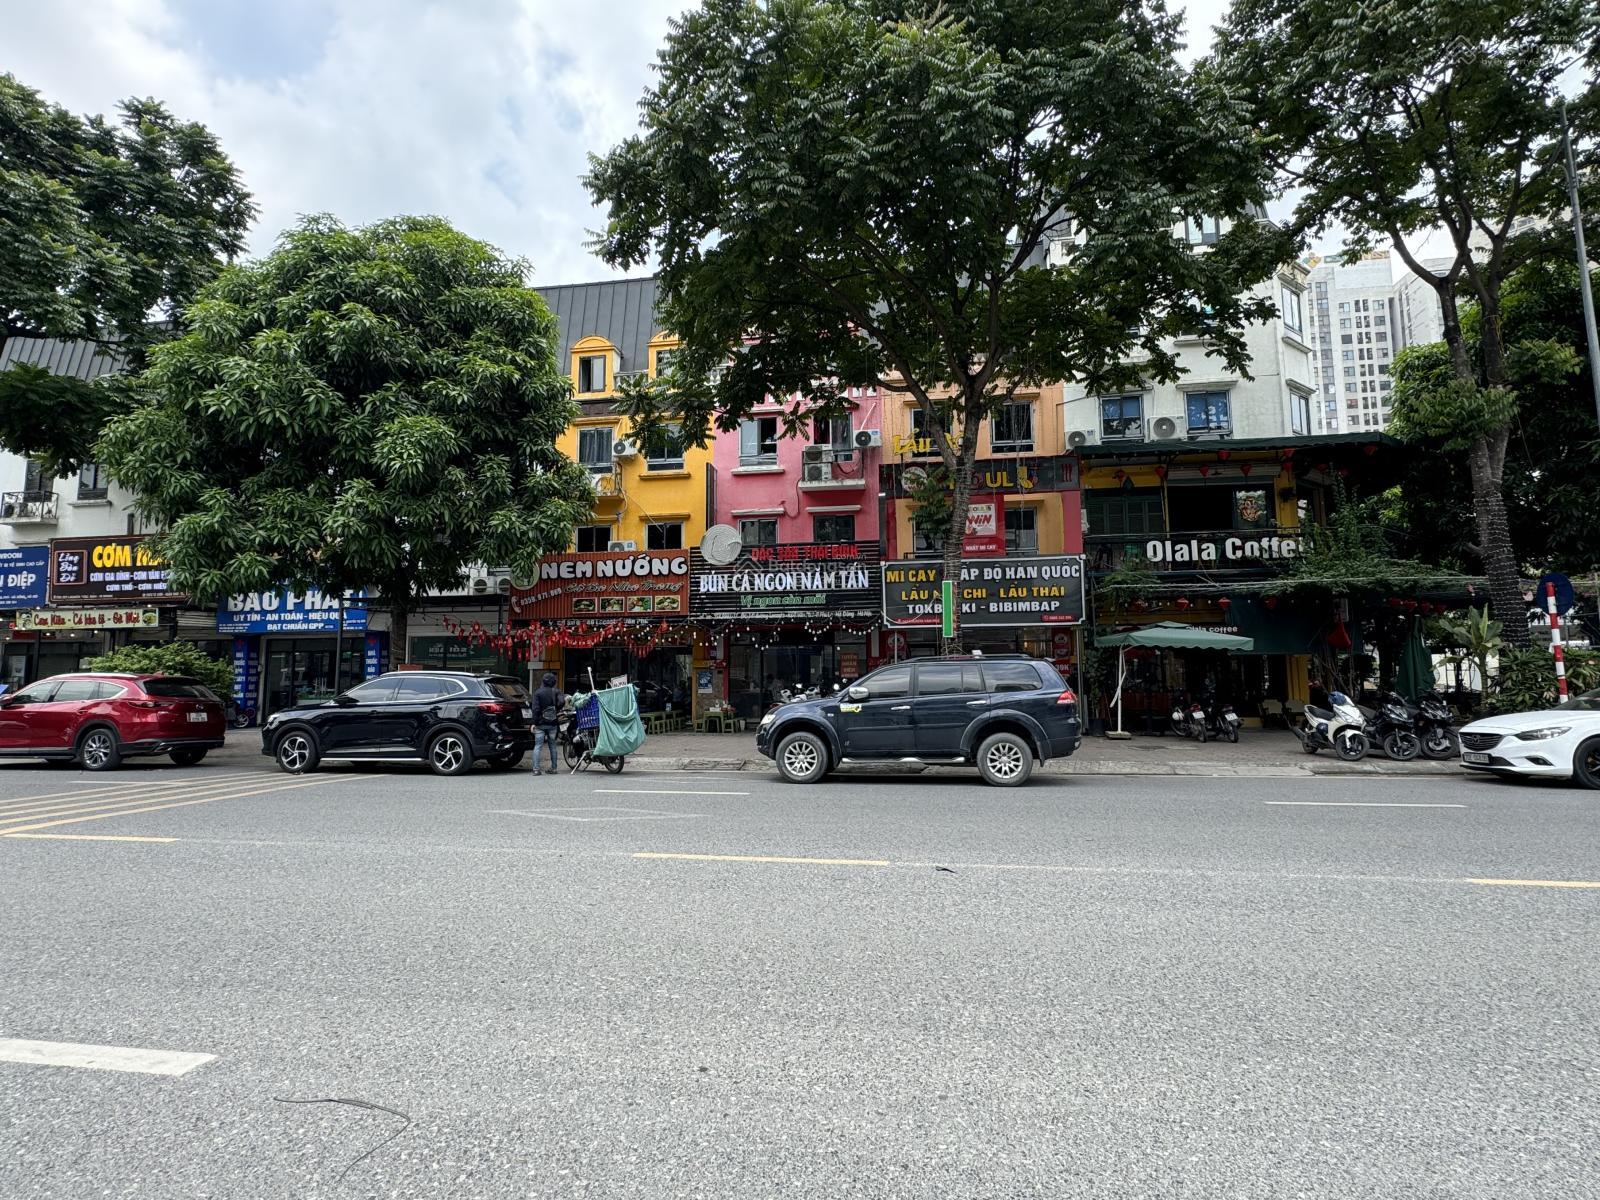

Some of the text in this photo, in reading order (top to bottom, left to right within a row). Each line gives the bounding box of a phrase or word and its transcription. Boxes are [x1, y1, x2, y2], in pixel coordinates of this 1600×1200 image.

[92, 543, 132, 568] CƠM
[1146, 536, 1304, 562] Olala Coffe
[541, 553, 687, 579] NEM NƯỚNG
[908, 569, 936, 582] CAY
[960, 561, 979, 581] ẤP
[983, 563, 1002, 583] ĐỘ
[1005, 562, 1038, 580] HÀN
[1041, 558, 1080, 581] QUỐC
[8, 570, 36, 590] ĐIỆP
[700, 570, 728, 592] BÚN
[732, 569, 750, 592] CÁ
[754, 572, 797, 592] NGON
[800, 566, 836, 591] NĂM
[233, 613, 245, 622] UY
[246, 612, 260, 621] TÍN
[265, 613, 278, 621] AN
[907, 600, 1060, 614] TOKBKI BIBIMBAP
[309, 622, 324, 630] GPP
[1209, 626, 1238, 634] coffee
